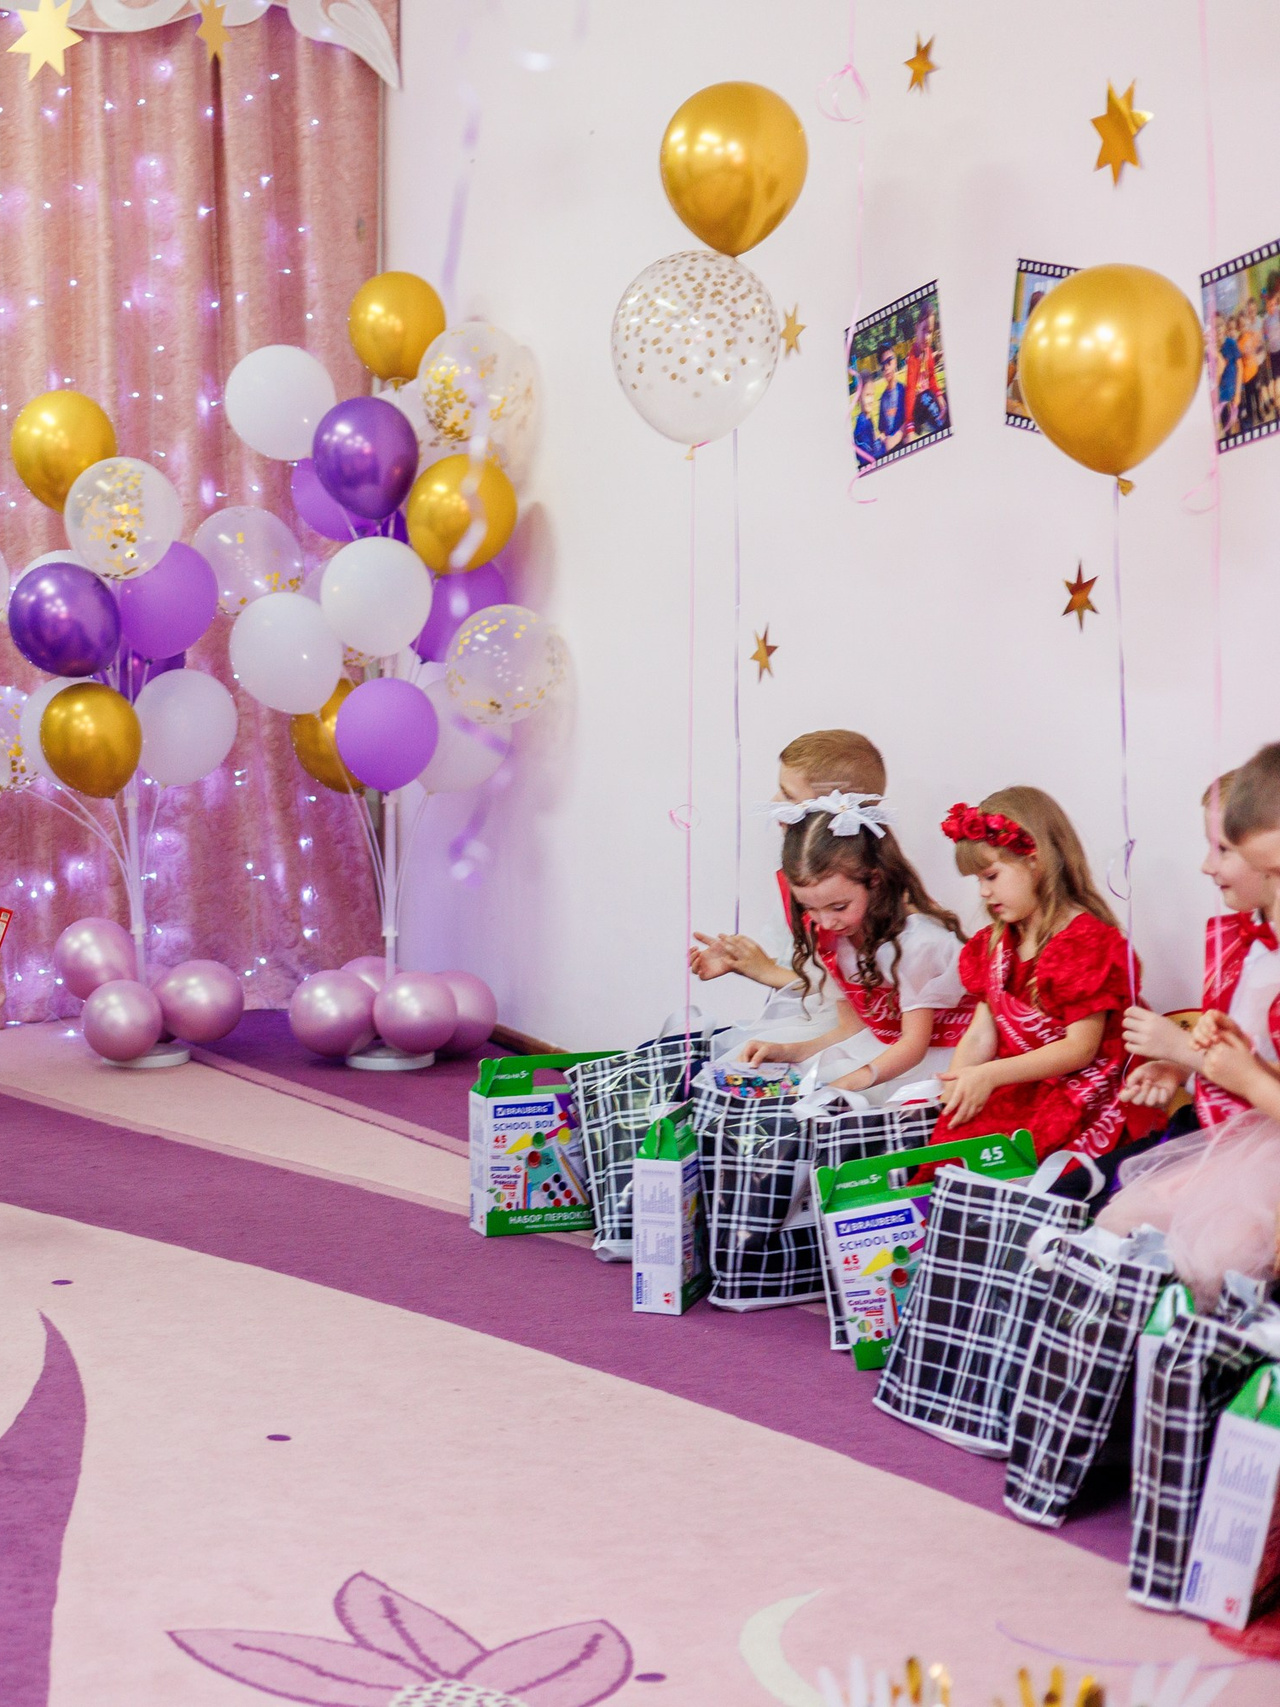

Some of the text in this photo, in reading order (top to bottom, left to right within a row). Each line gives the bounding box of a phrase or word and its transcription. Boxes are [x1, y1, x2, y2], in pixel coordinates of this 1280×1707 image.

[506, 1105, 549, 1115] BRAUBERG
[493, 1119, 555, 1132] SCHOOL BOX
[494, 1135, 507, 1144] 45
[980, 1146, 1004, 1162] 45
[508, 1214, 542, 1225] НАБОР
[850, 1213, 906, 1230] BRAUBERG
[839, 1229, 918, 1252] SCHOOL BOX
[843, 1254, 859, 1265] 45
